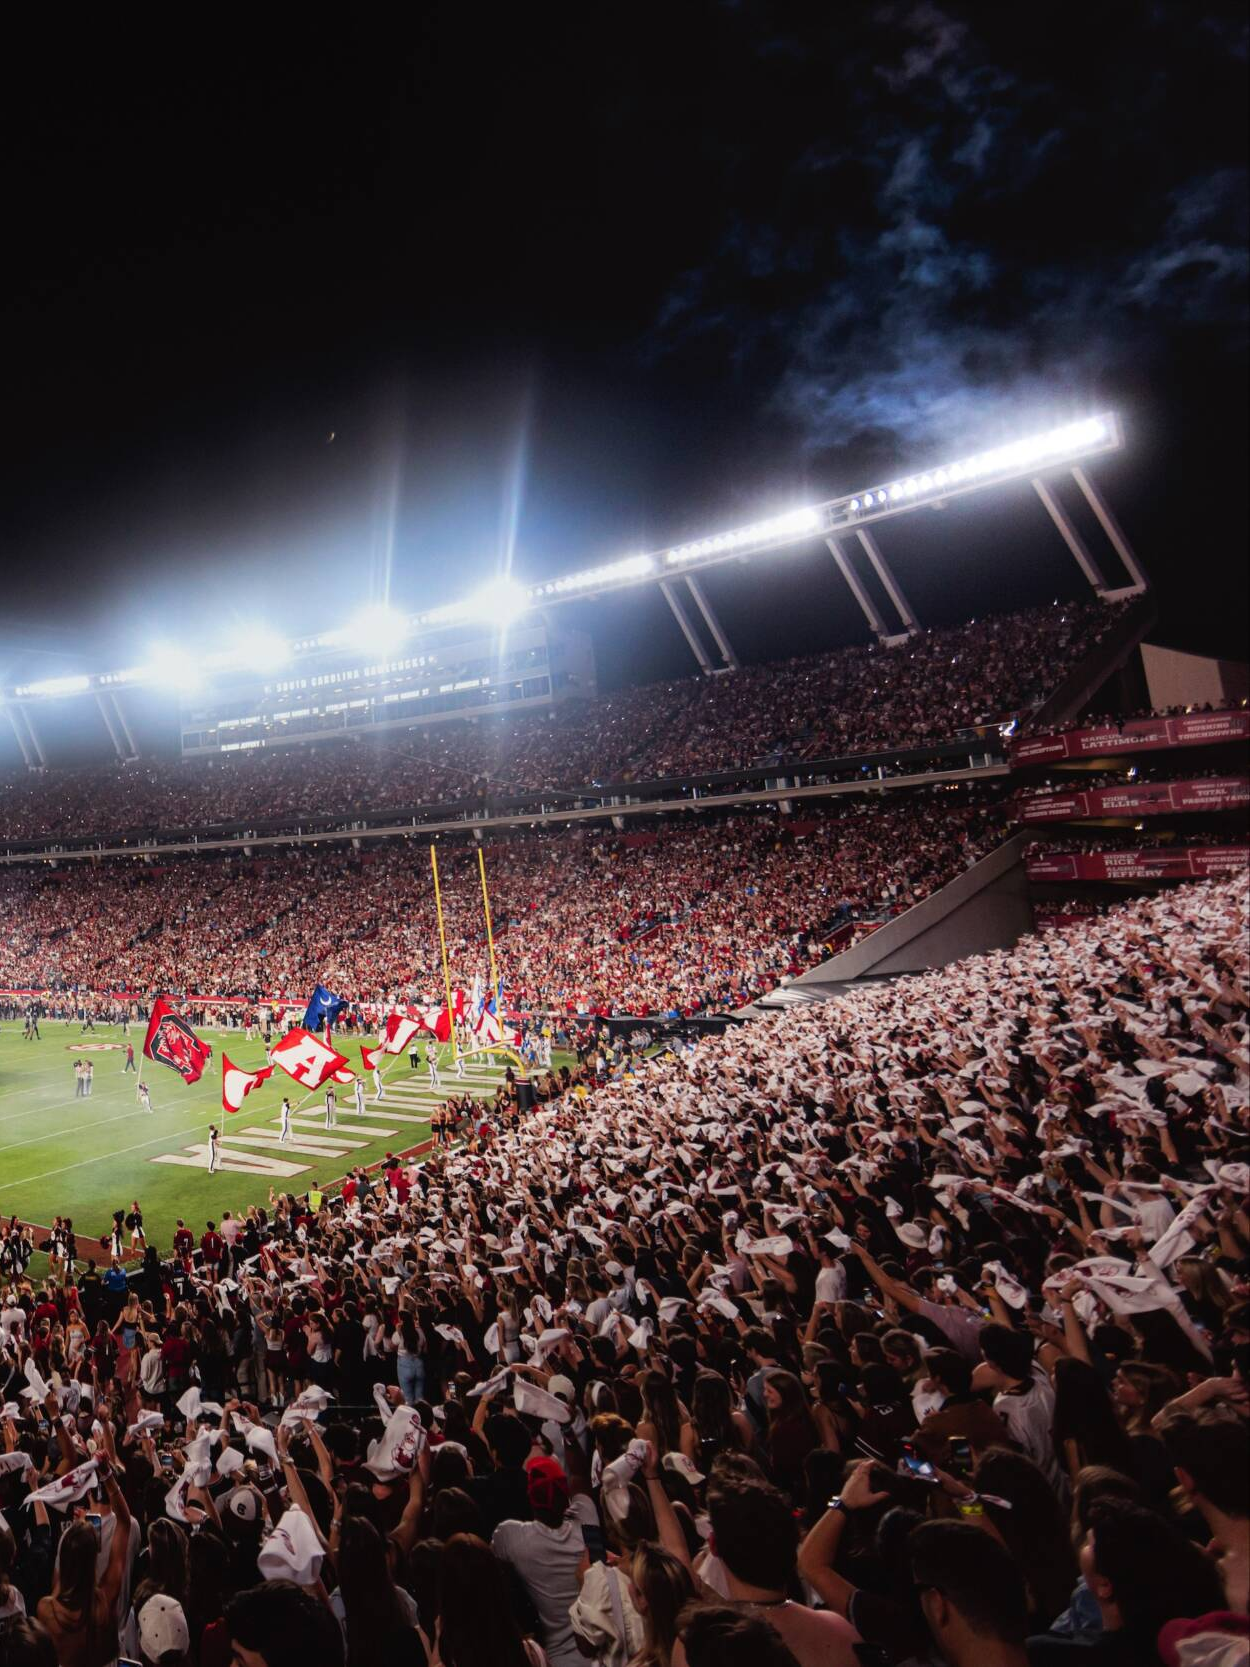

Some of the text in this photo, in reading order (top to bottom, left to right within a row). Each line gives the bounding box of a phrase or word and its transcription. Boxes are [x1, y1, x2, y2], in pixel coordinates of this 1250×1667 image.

[276, 656, 425, 693] SOUTH CAROLINA GAMECOCKS
[1187, 722, 1230, 732] RUSHING
[1178, 729, 1244, 741] TOUCHDOWNS
[1082, 734, 1159, 750] LATTIMORE
[1197, 789, 1228, 797] TOTAL
[1102, 799, 1139, 809] ELLIS
[1182, 796, 1222, 805] PASSING
[1104, 858, 1135, 866] RICE
[1107, 869, 1164, 879] JEFFERY
